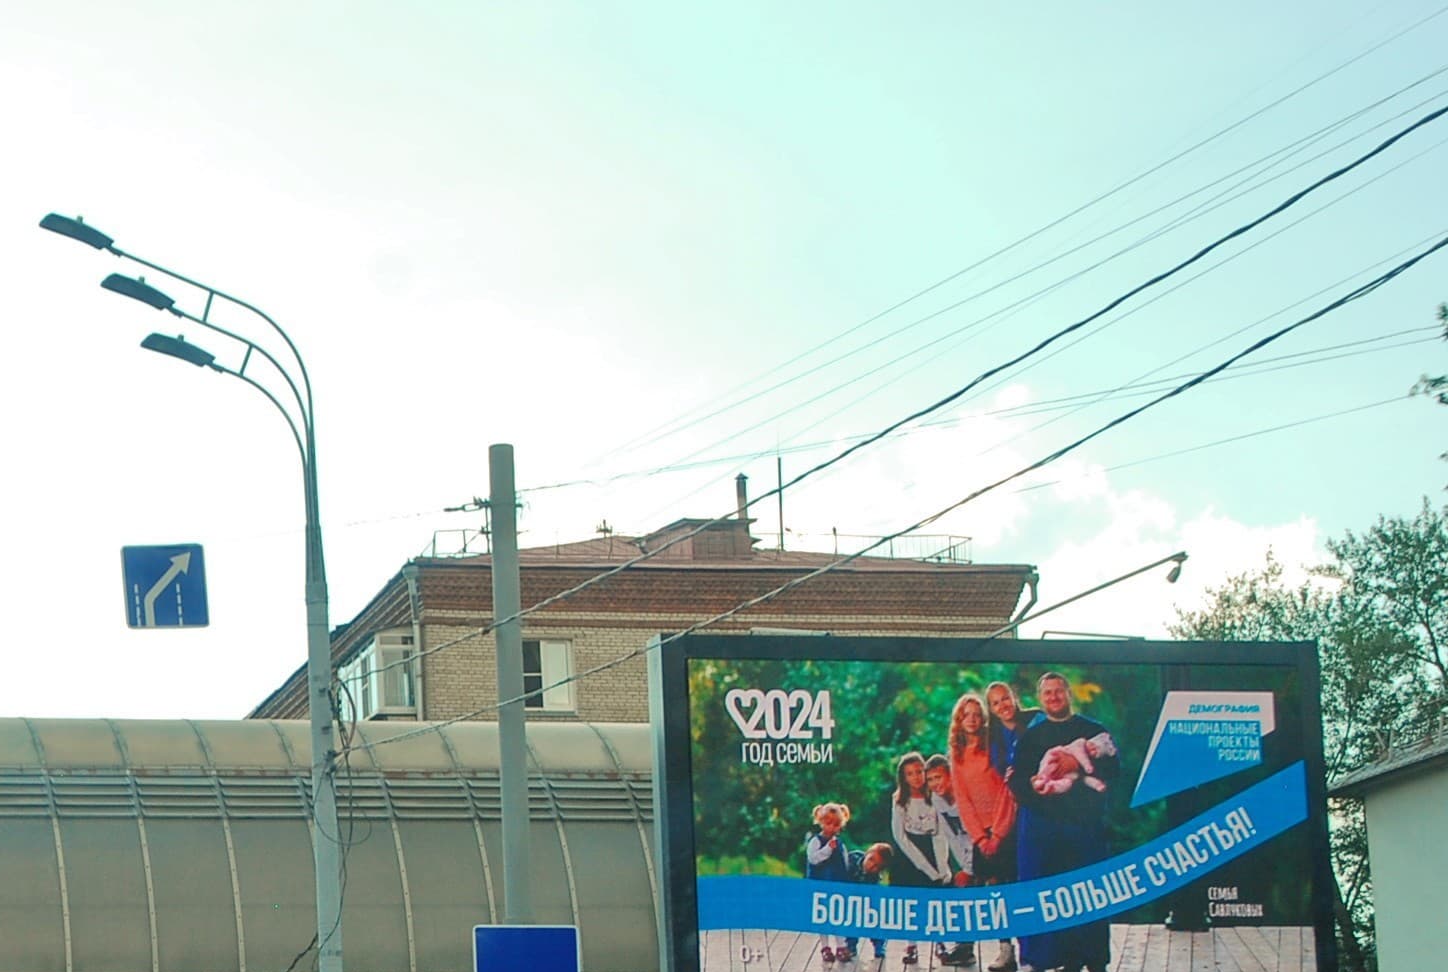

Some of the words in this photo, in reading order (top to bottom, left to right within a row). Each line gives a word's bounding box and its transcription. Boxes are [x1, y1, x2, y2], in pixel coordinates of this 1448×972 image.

[725, 688, 836, 740] 2024
[1188, 704, 1260, 714] ДЕМОГРАФИЯ
[1168, 722, 1259, 736] НАЦИОНАЛЬНЫЕ
[1208, 735, 1260, 748] ПРОЕКТЫ
[1218, 748, 1260, 761] РОССИИ
[811, 891, 918, 931] БОЛЬШЕ
[925, 893, 1009, 936] ДЕТЕЙ
[1039, 863, 1147, 924] БОЛЬШЕ
[1144, 806, 1258, 887] СЧАСТЬЯ!
[740, 945, 764, 963] 0+
